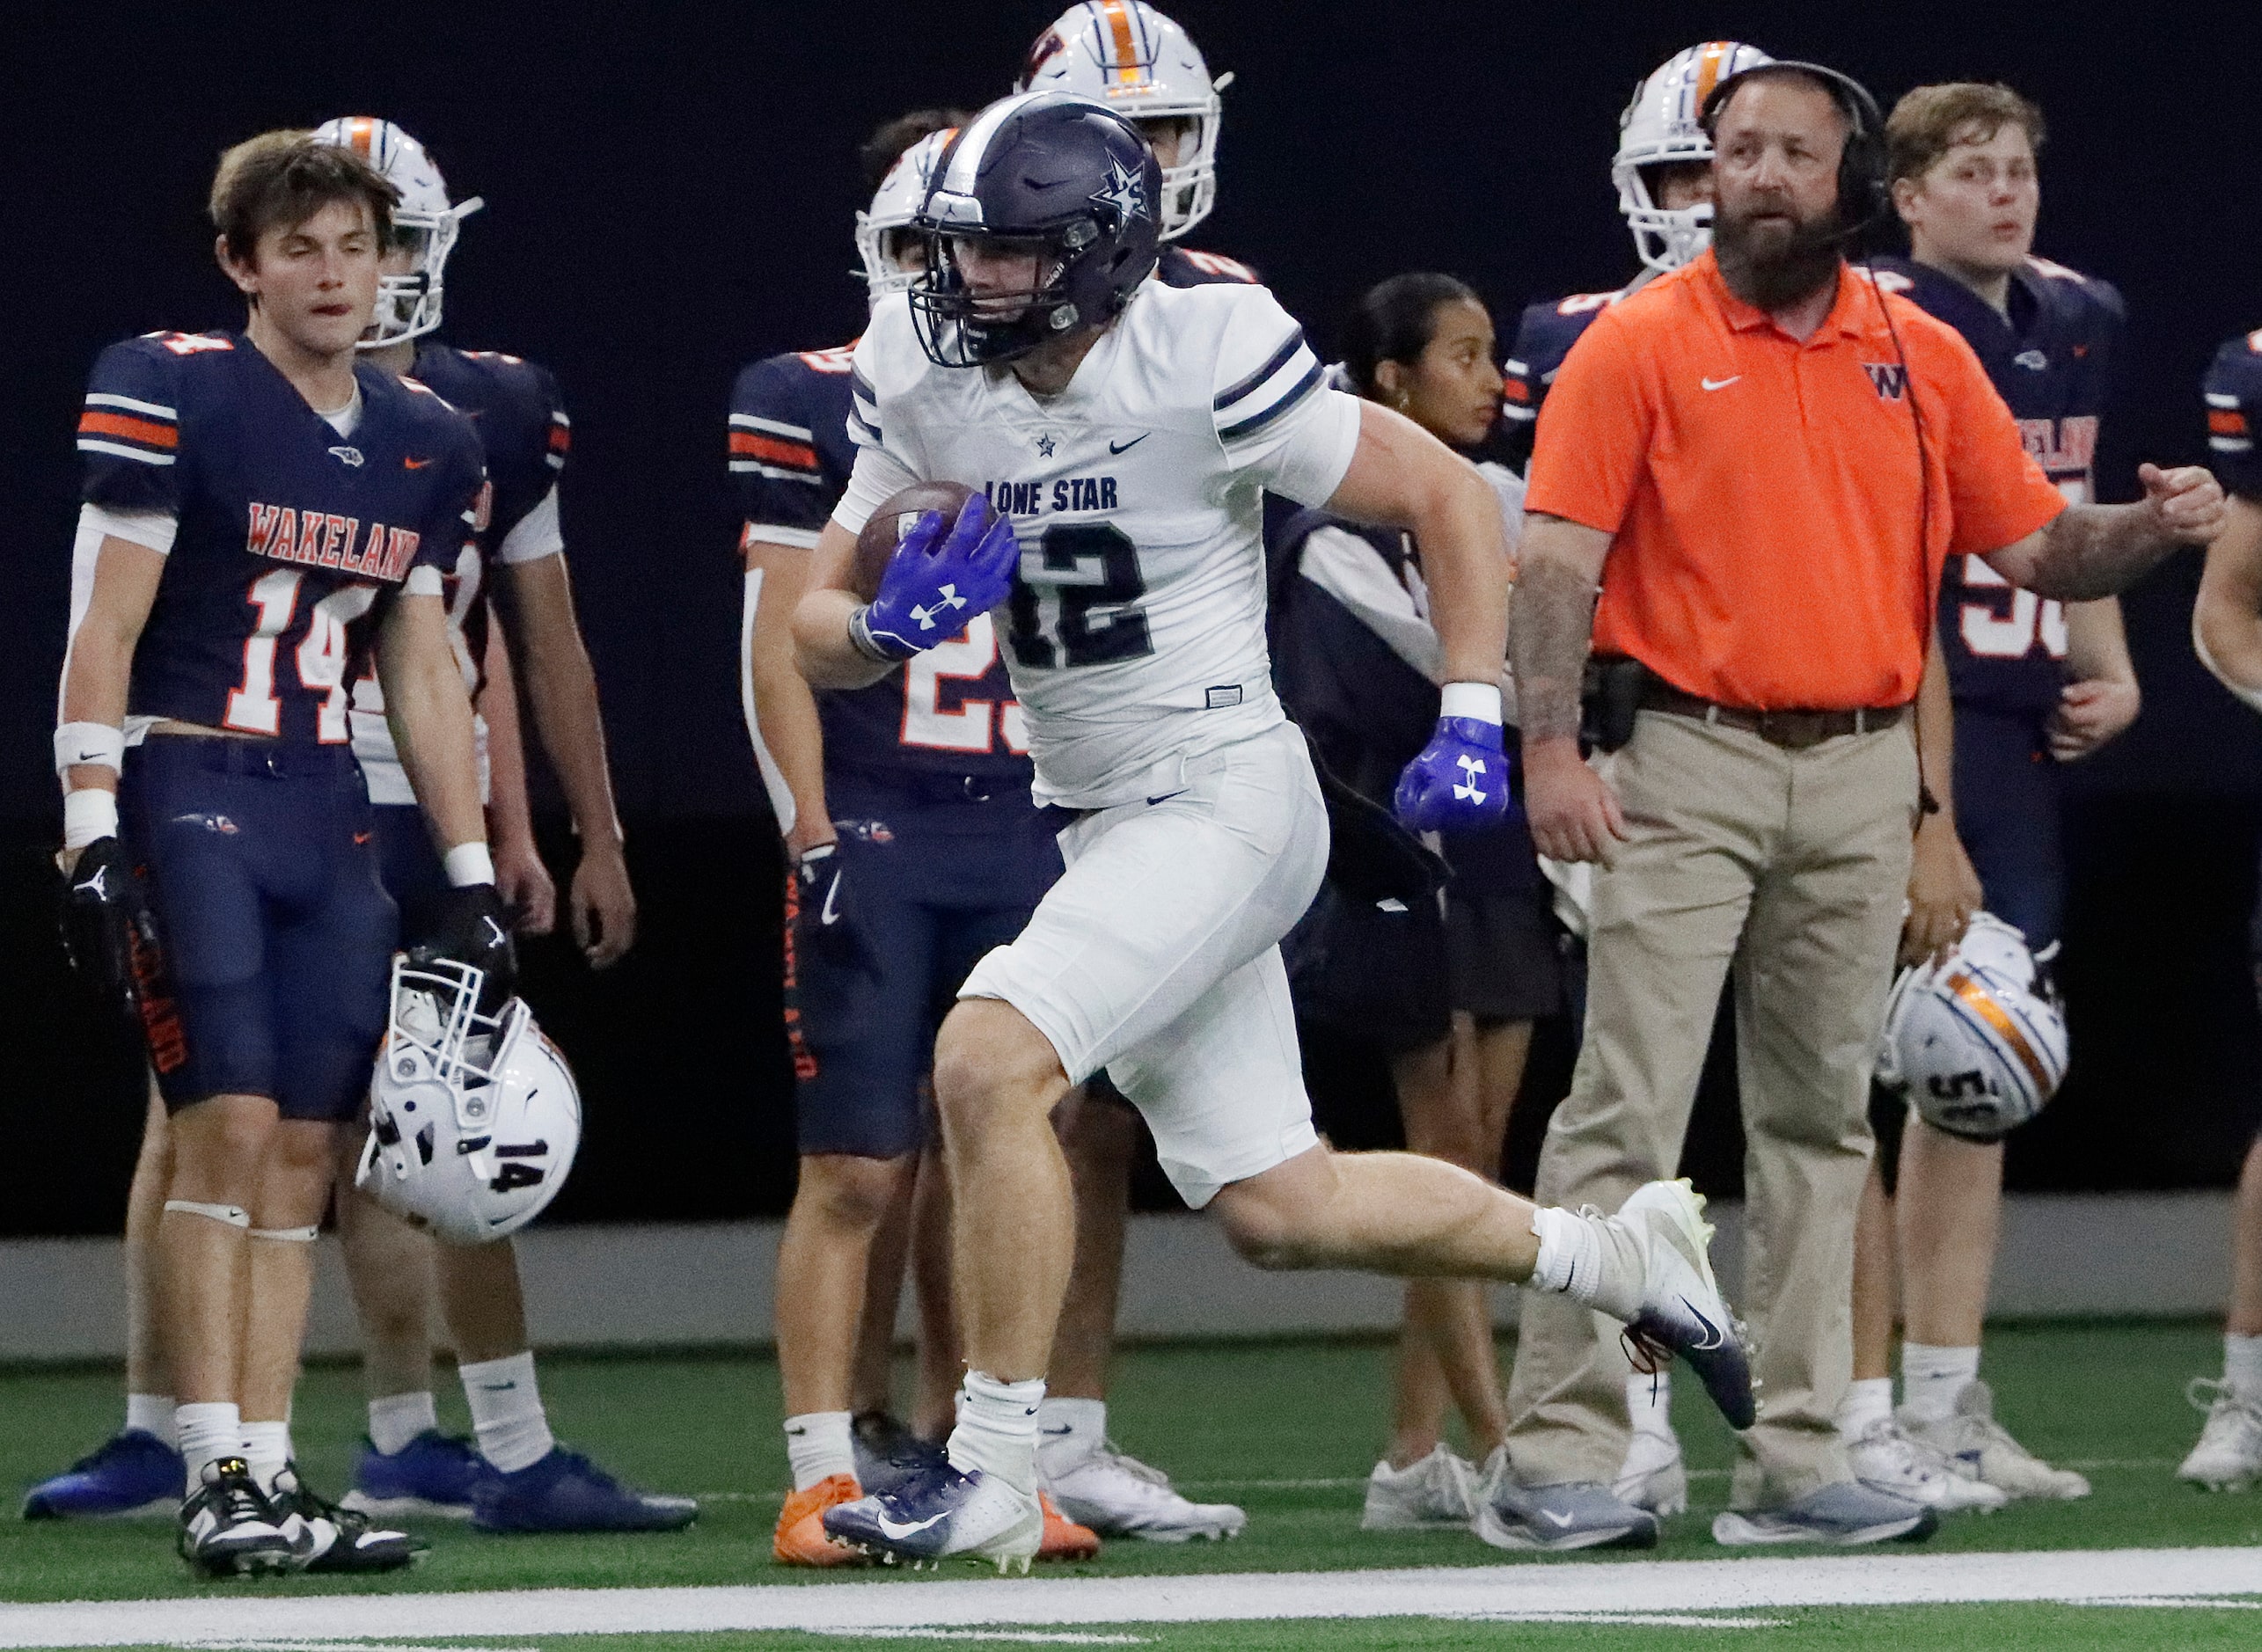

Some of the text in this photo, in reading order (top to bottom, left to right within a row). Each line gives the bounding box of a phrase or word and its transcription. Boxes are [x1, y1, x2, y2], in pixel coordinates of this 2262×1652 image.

[1862, 362, 1908, 401] W
[1051, 477, 1117, 512] STAR
[1009, 520, 1155, 669] 12
[223, 568, 380, 746] 14
[899, 610, 1031, 756] 2
[490, 1138, 549, 1193] 14
